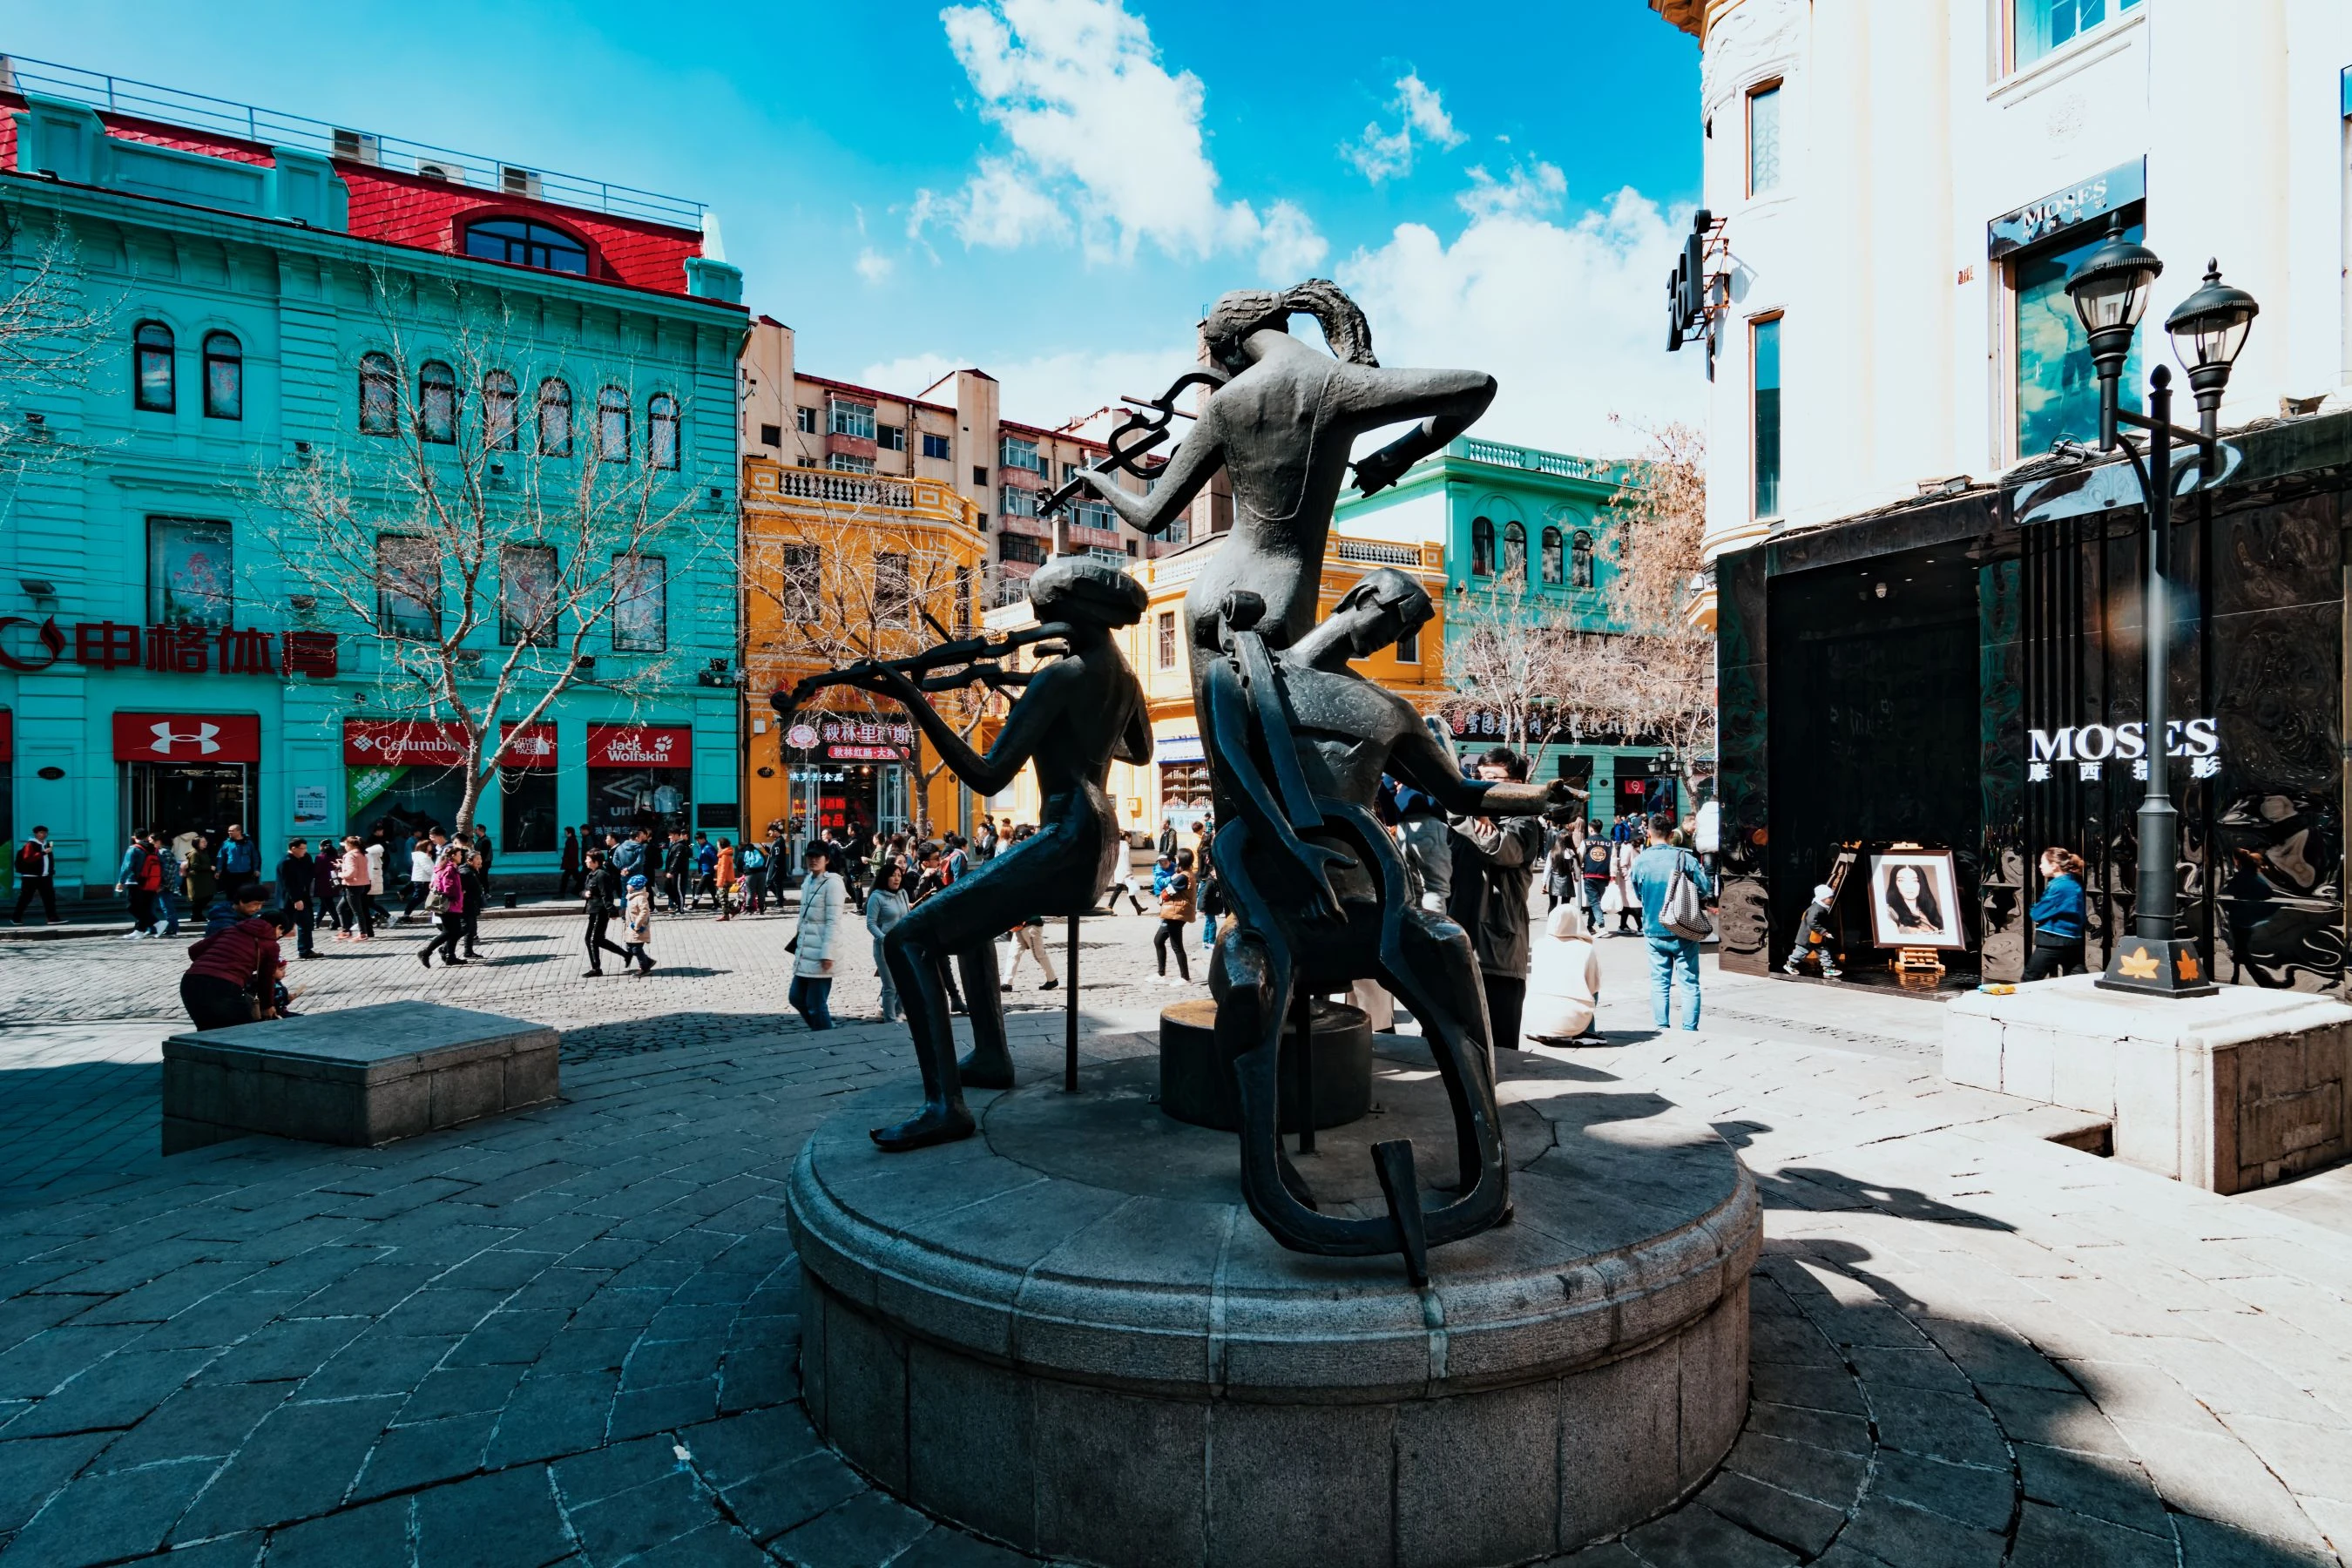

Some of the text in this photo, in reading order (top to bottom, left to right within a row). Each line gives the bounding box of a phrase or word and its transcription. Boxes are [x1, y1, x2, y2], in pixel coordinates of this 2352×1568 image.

[2023, 179, 2107, 227] MOSES
[75, 620, 338, 679] 申格体育
[607, 740, 642, 751] Jack
[607, 750, 669, 762] Wolfskin
[834, 747, 904, 757] 秋林红肠·大列
